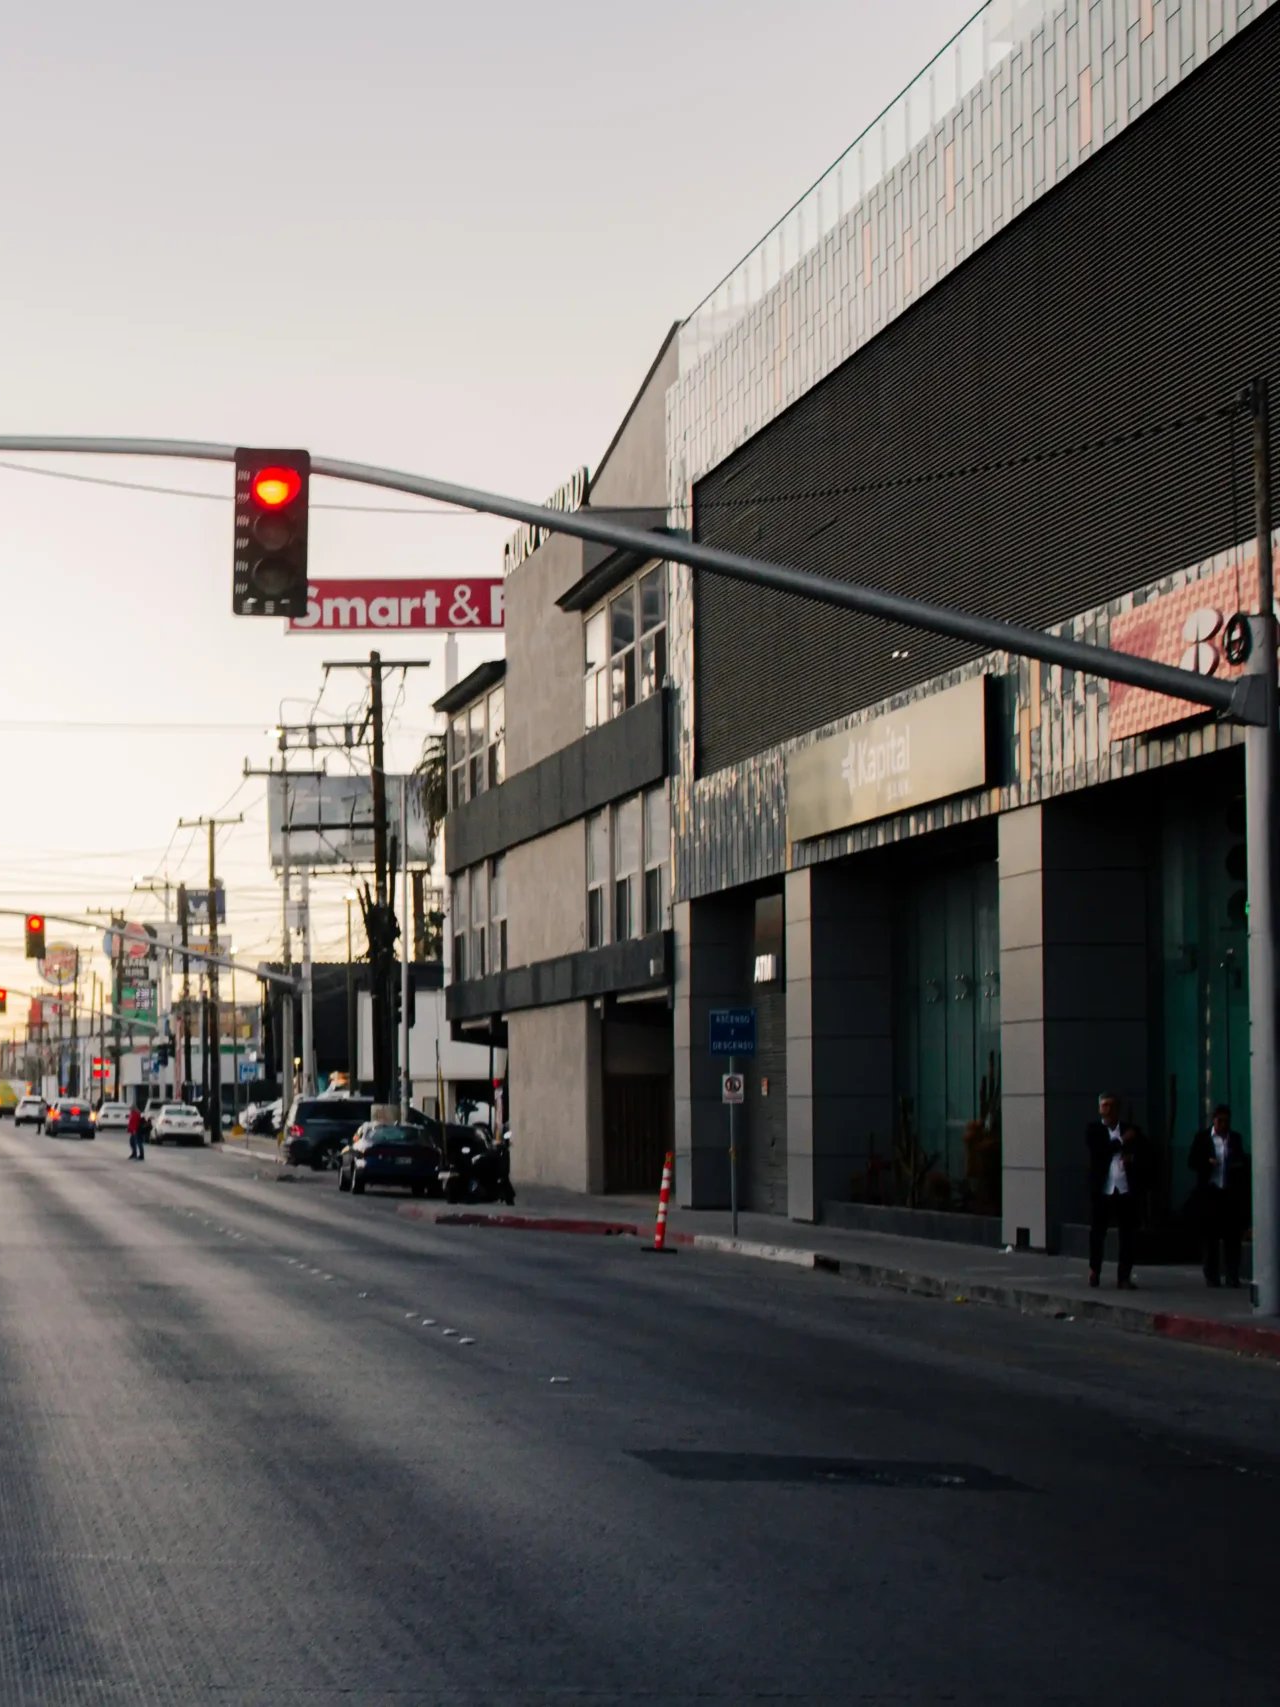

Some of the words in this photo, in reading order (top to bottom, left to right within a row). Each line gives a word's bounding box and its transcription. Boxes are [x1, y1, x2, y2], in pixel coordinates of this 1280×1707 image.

[293, 585, 440, 628] Smart
[448, 584, 481, 626] &
[857, 724, 910, 792] Kapital
[716, 1015, 750, 1024] ASCENSO
[712, 1040, 753, 1051] DESCENSO
